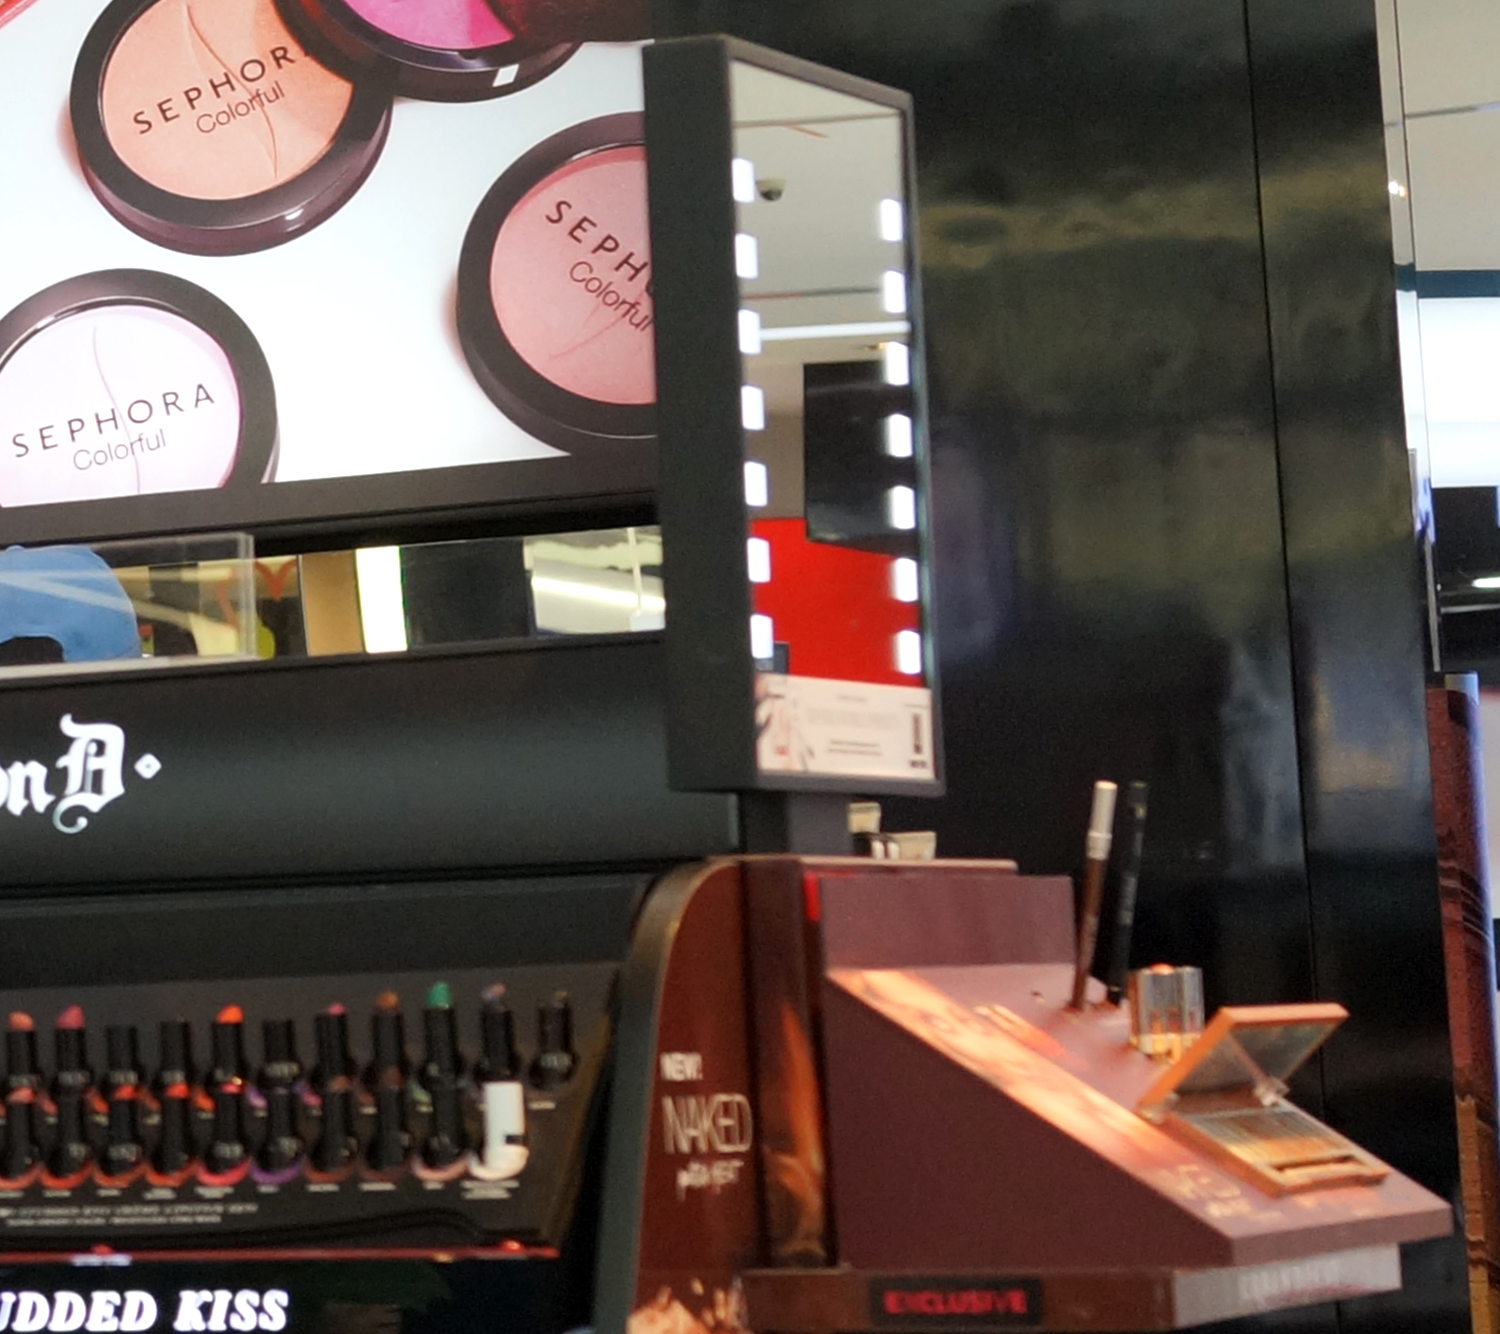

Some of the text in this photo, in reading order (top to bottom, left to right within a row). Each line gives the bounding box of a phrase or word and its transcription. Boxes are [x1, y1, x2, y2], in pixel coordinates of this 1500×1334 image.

[132, 42, 312, 135] SEPHOR
[196, 81, 286, 135] Colorful
[11, 382, 215, 459] SEPHORA
[72, 428, 168, 472] Colorful
[661, 1092, 753, 1155] NAKED
[172, 1287, 290, 1333] KISS
[882, 1289, 1028, 1315] EXCLUSIVE
